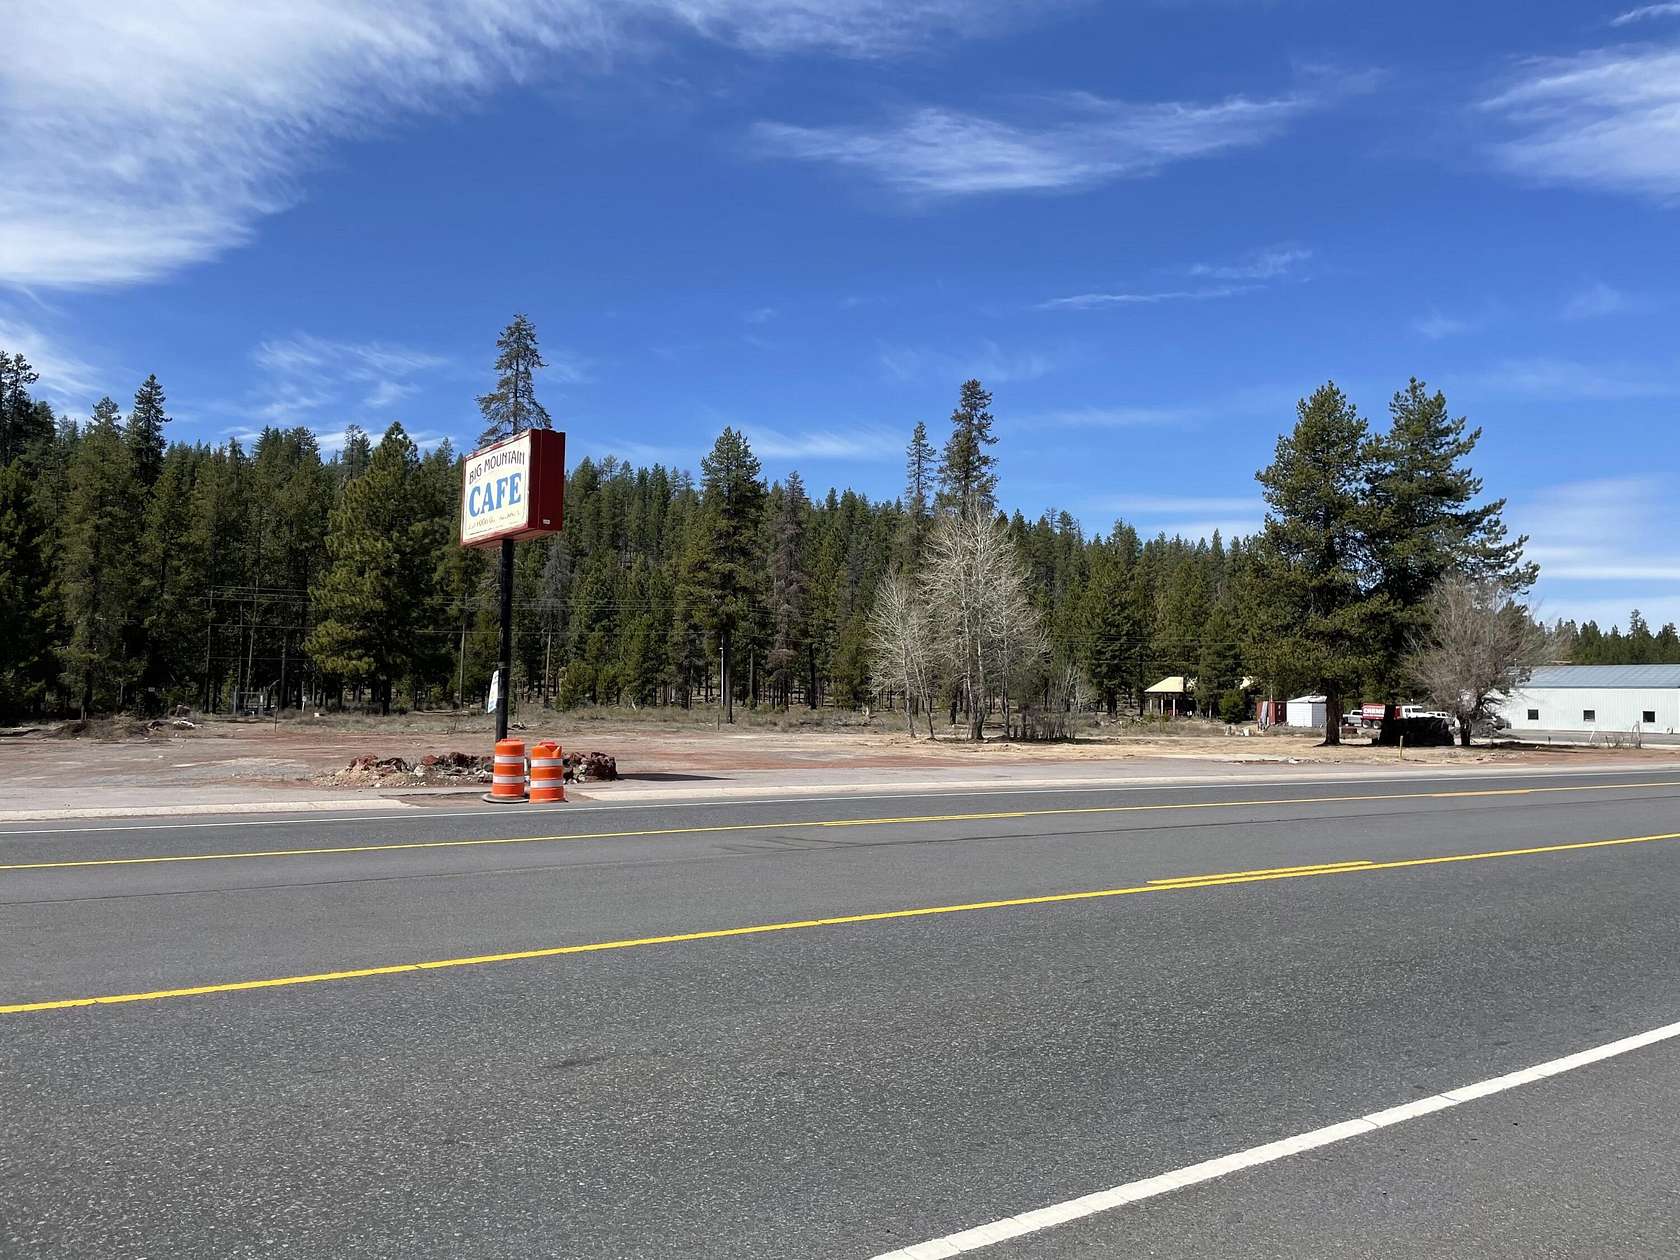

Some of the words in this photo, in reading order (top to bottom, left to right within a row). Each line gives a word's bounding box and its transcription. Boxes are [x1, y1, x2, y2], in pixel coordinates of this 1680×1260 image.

[469, 463, 482, 484] BIG
[484, 450, 525, 472] MOUNTAIN
[469, 472, 522, 517] CAFE
